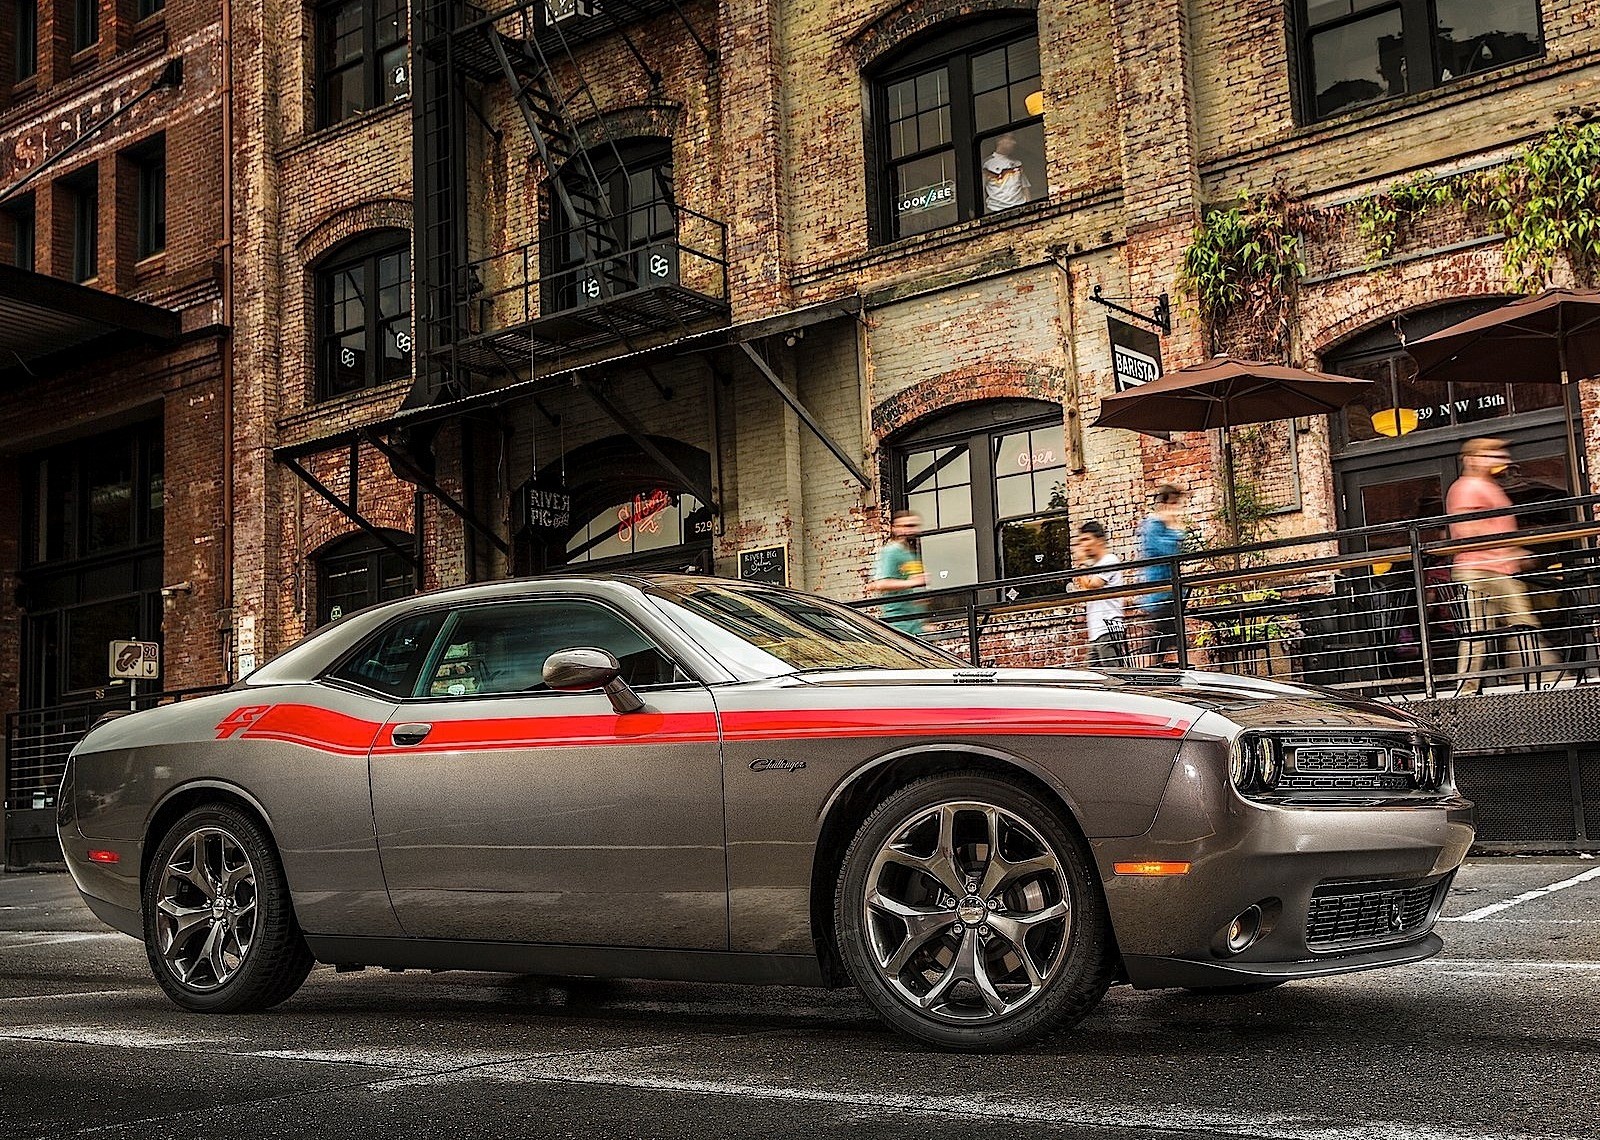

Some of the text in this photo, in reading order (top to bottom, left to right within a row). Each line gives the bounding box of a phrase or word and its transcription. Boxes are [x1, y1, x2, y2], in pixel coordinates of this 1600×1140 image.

[649, 254, 669, 278] GS
[396, 331, 411, 352] GS
[341, 348, 355, 368] GS
[1115, 352, 1154, 382] BARISTA
[1477, 394, 1505, 410] 13th
[1017, 450, 1056, 472] Open
[530, 508, 552, 527] PIG
[694, 520, 712, 534] 529
[144, 645, 157, 658] 90
[748, 757, 807, 773] Challenger
